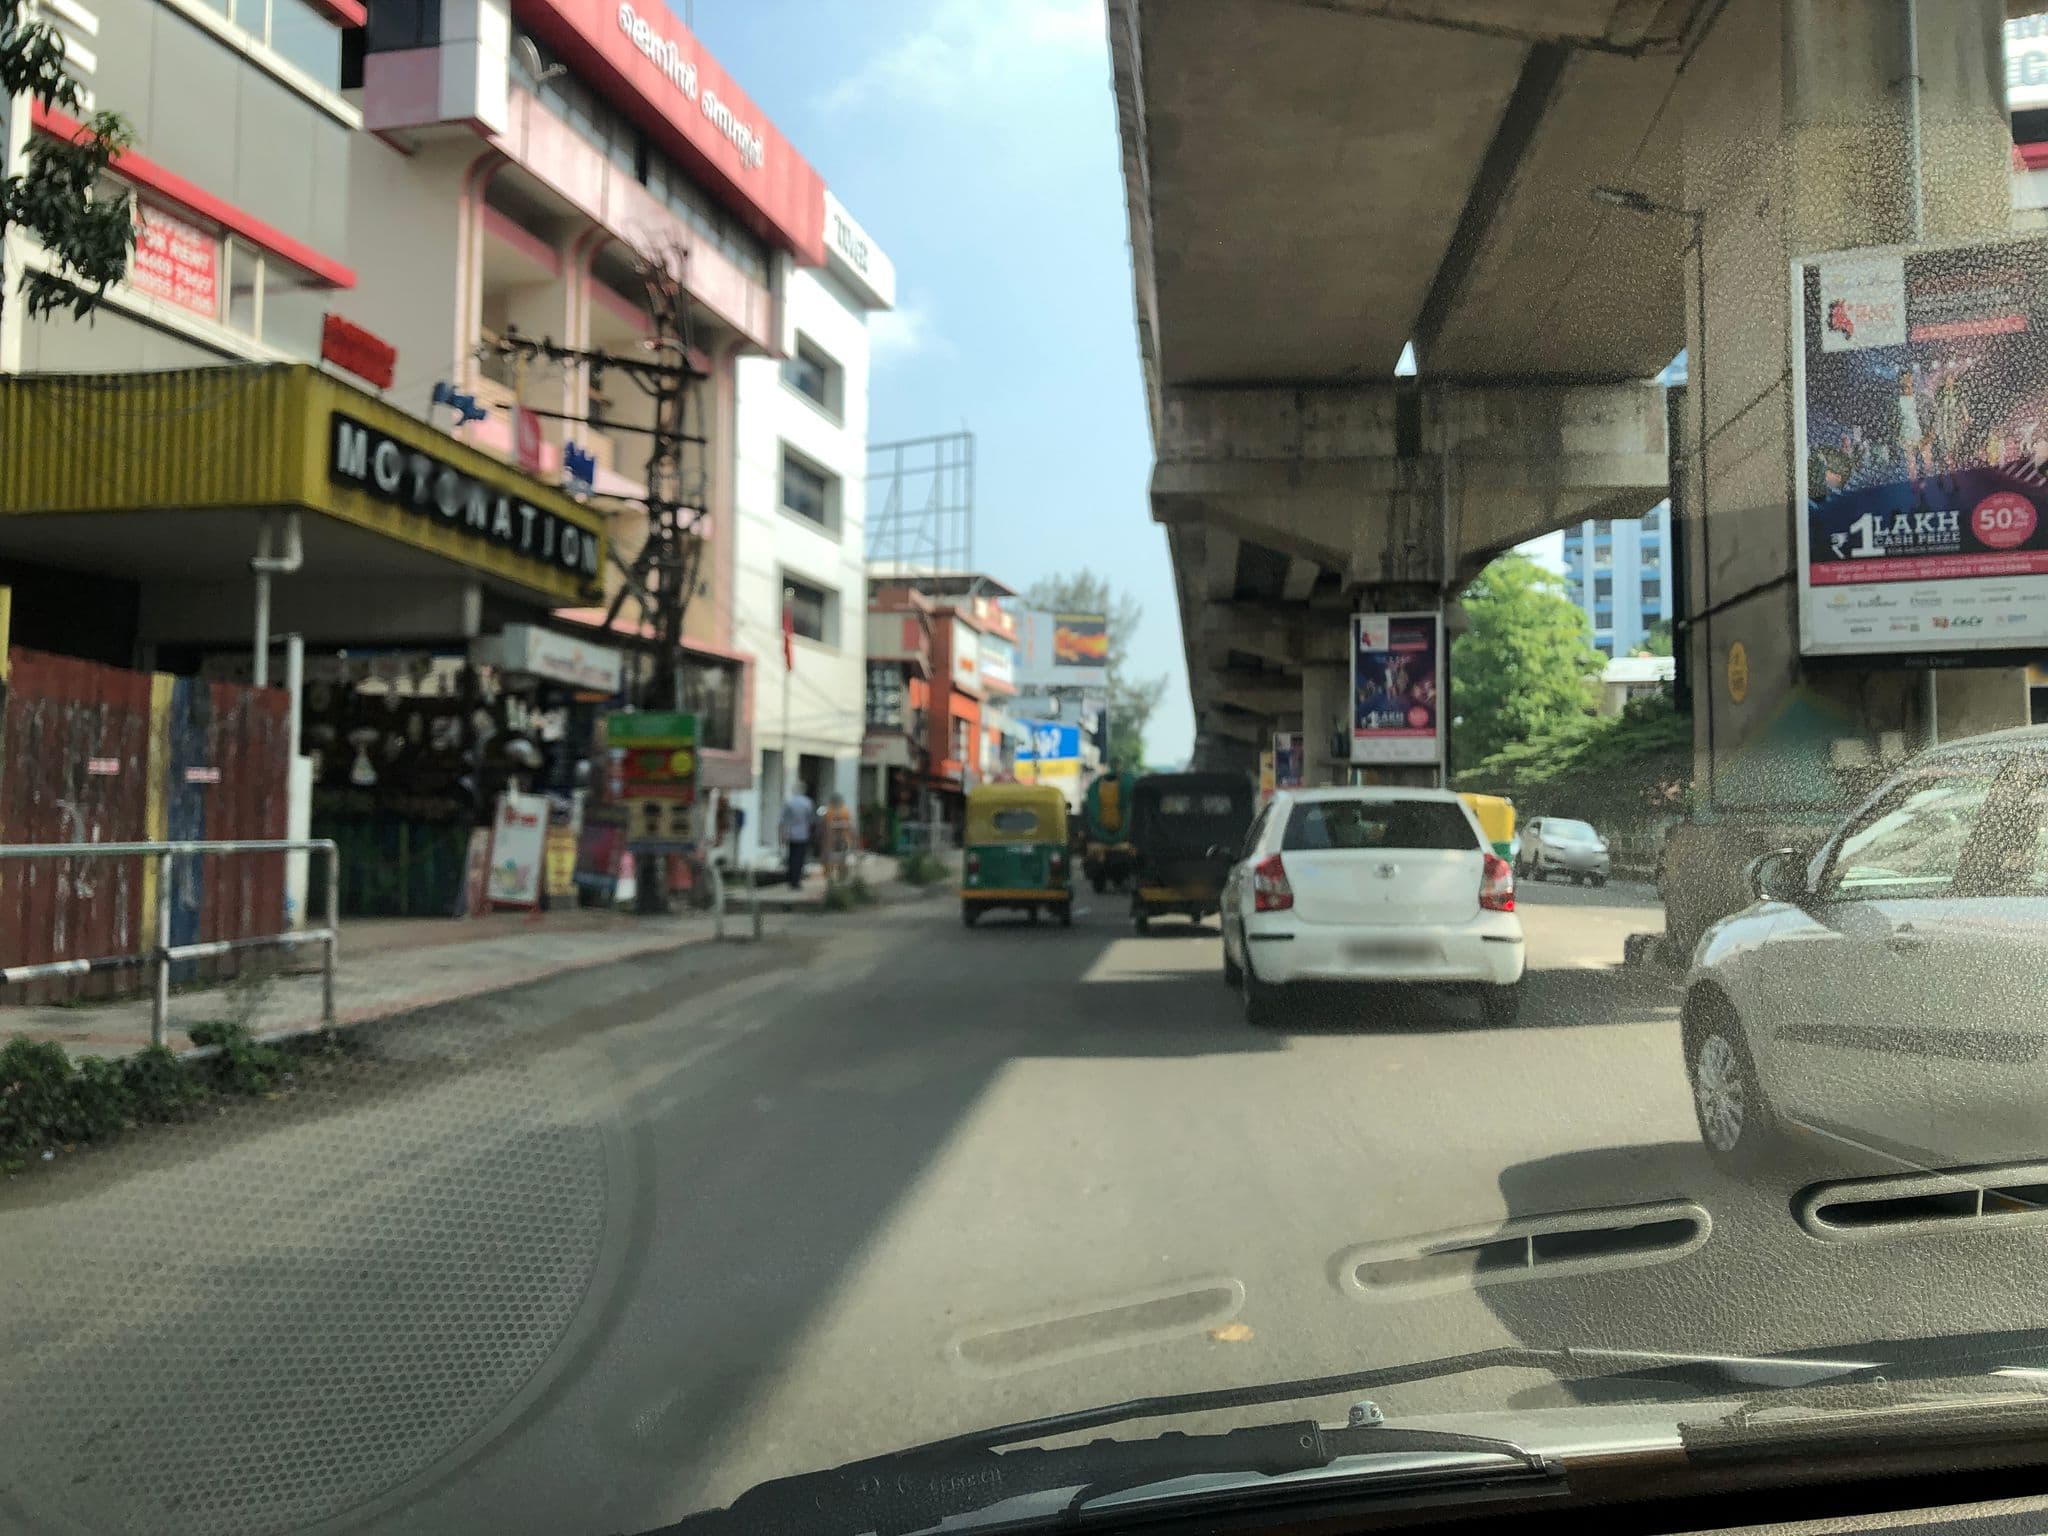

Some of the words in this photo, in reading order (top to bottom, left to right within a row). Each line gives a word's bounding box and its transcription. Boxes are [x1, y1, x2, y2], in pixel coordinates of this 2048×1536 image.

[1874, 510, 1960, 536] LAKH
[1874, 534, 1914, 546] CASH
[1918, 531, 1961, 545] PRIZE
